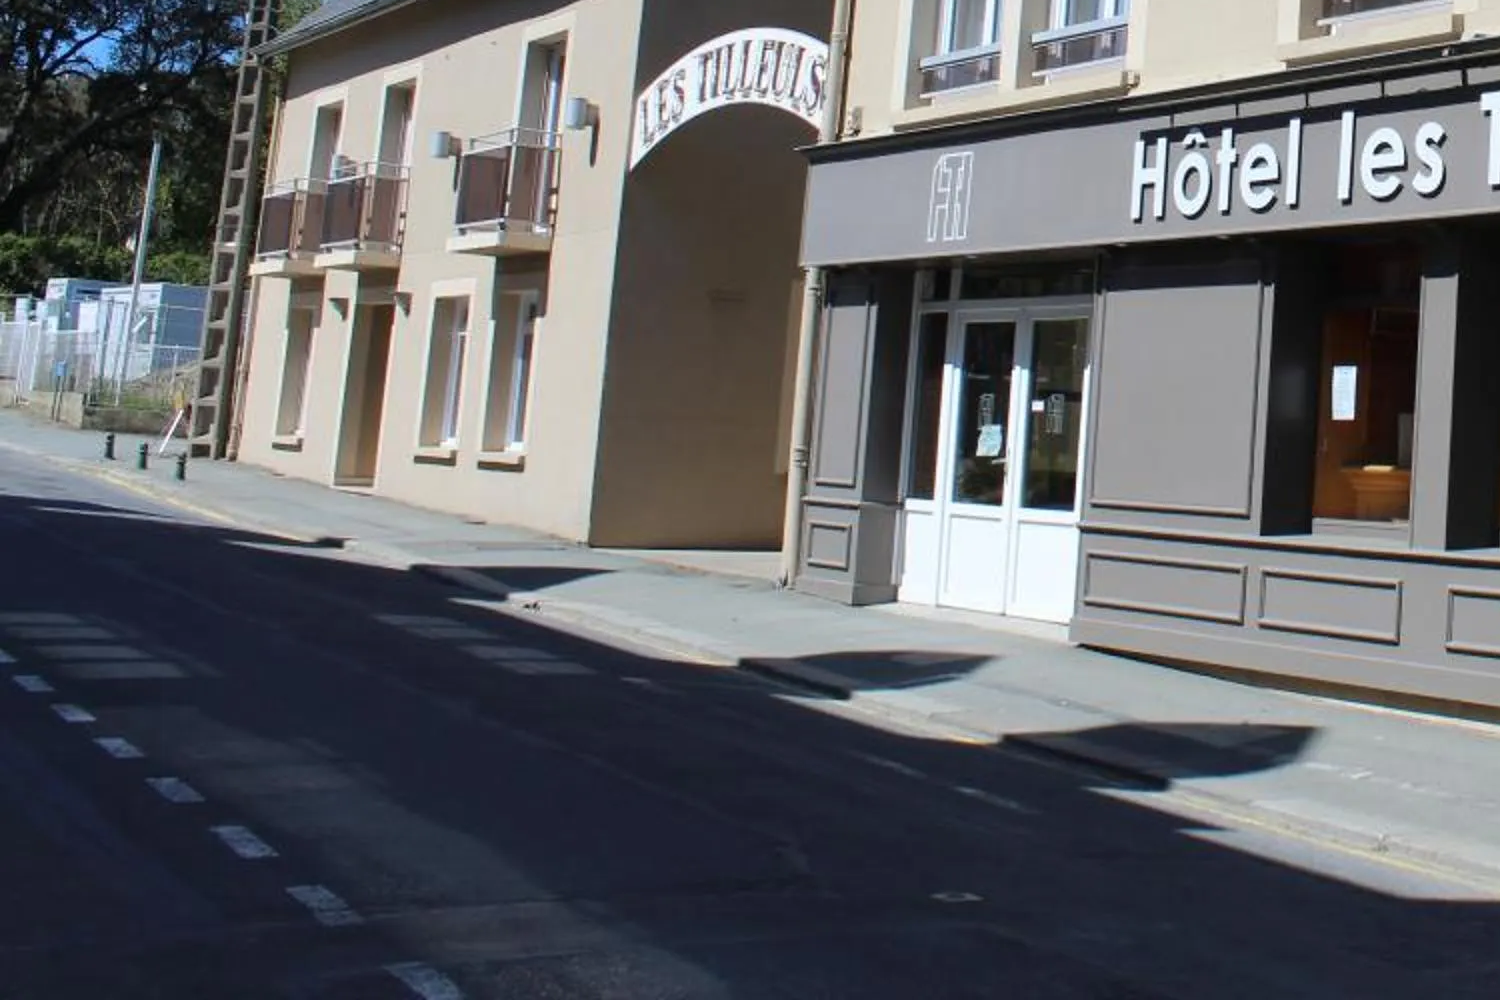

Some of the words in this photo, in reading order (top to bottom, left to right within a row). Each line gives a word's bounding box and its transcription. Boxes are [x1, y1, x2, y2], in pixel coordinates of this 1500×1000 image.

[639, 68, 686, 148] LES
[694, 39, 828, 116] TILLEULS
[1130, 117, 1302, 220] Hôtel
[1337, 110, 1447, 199] les
